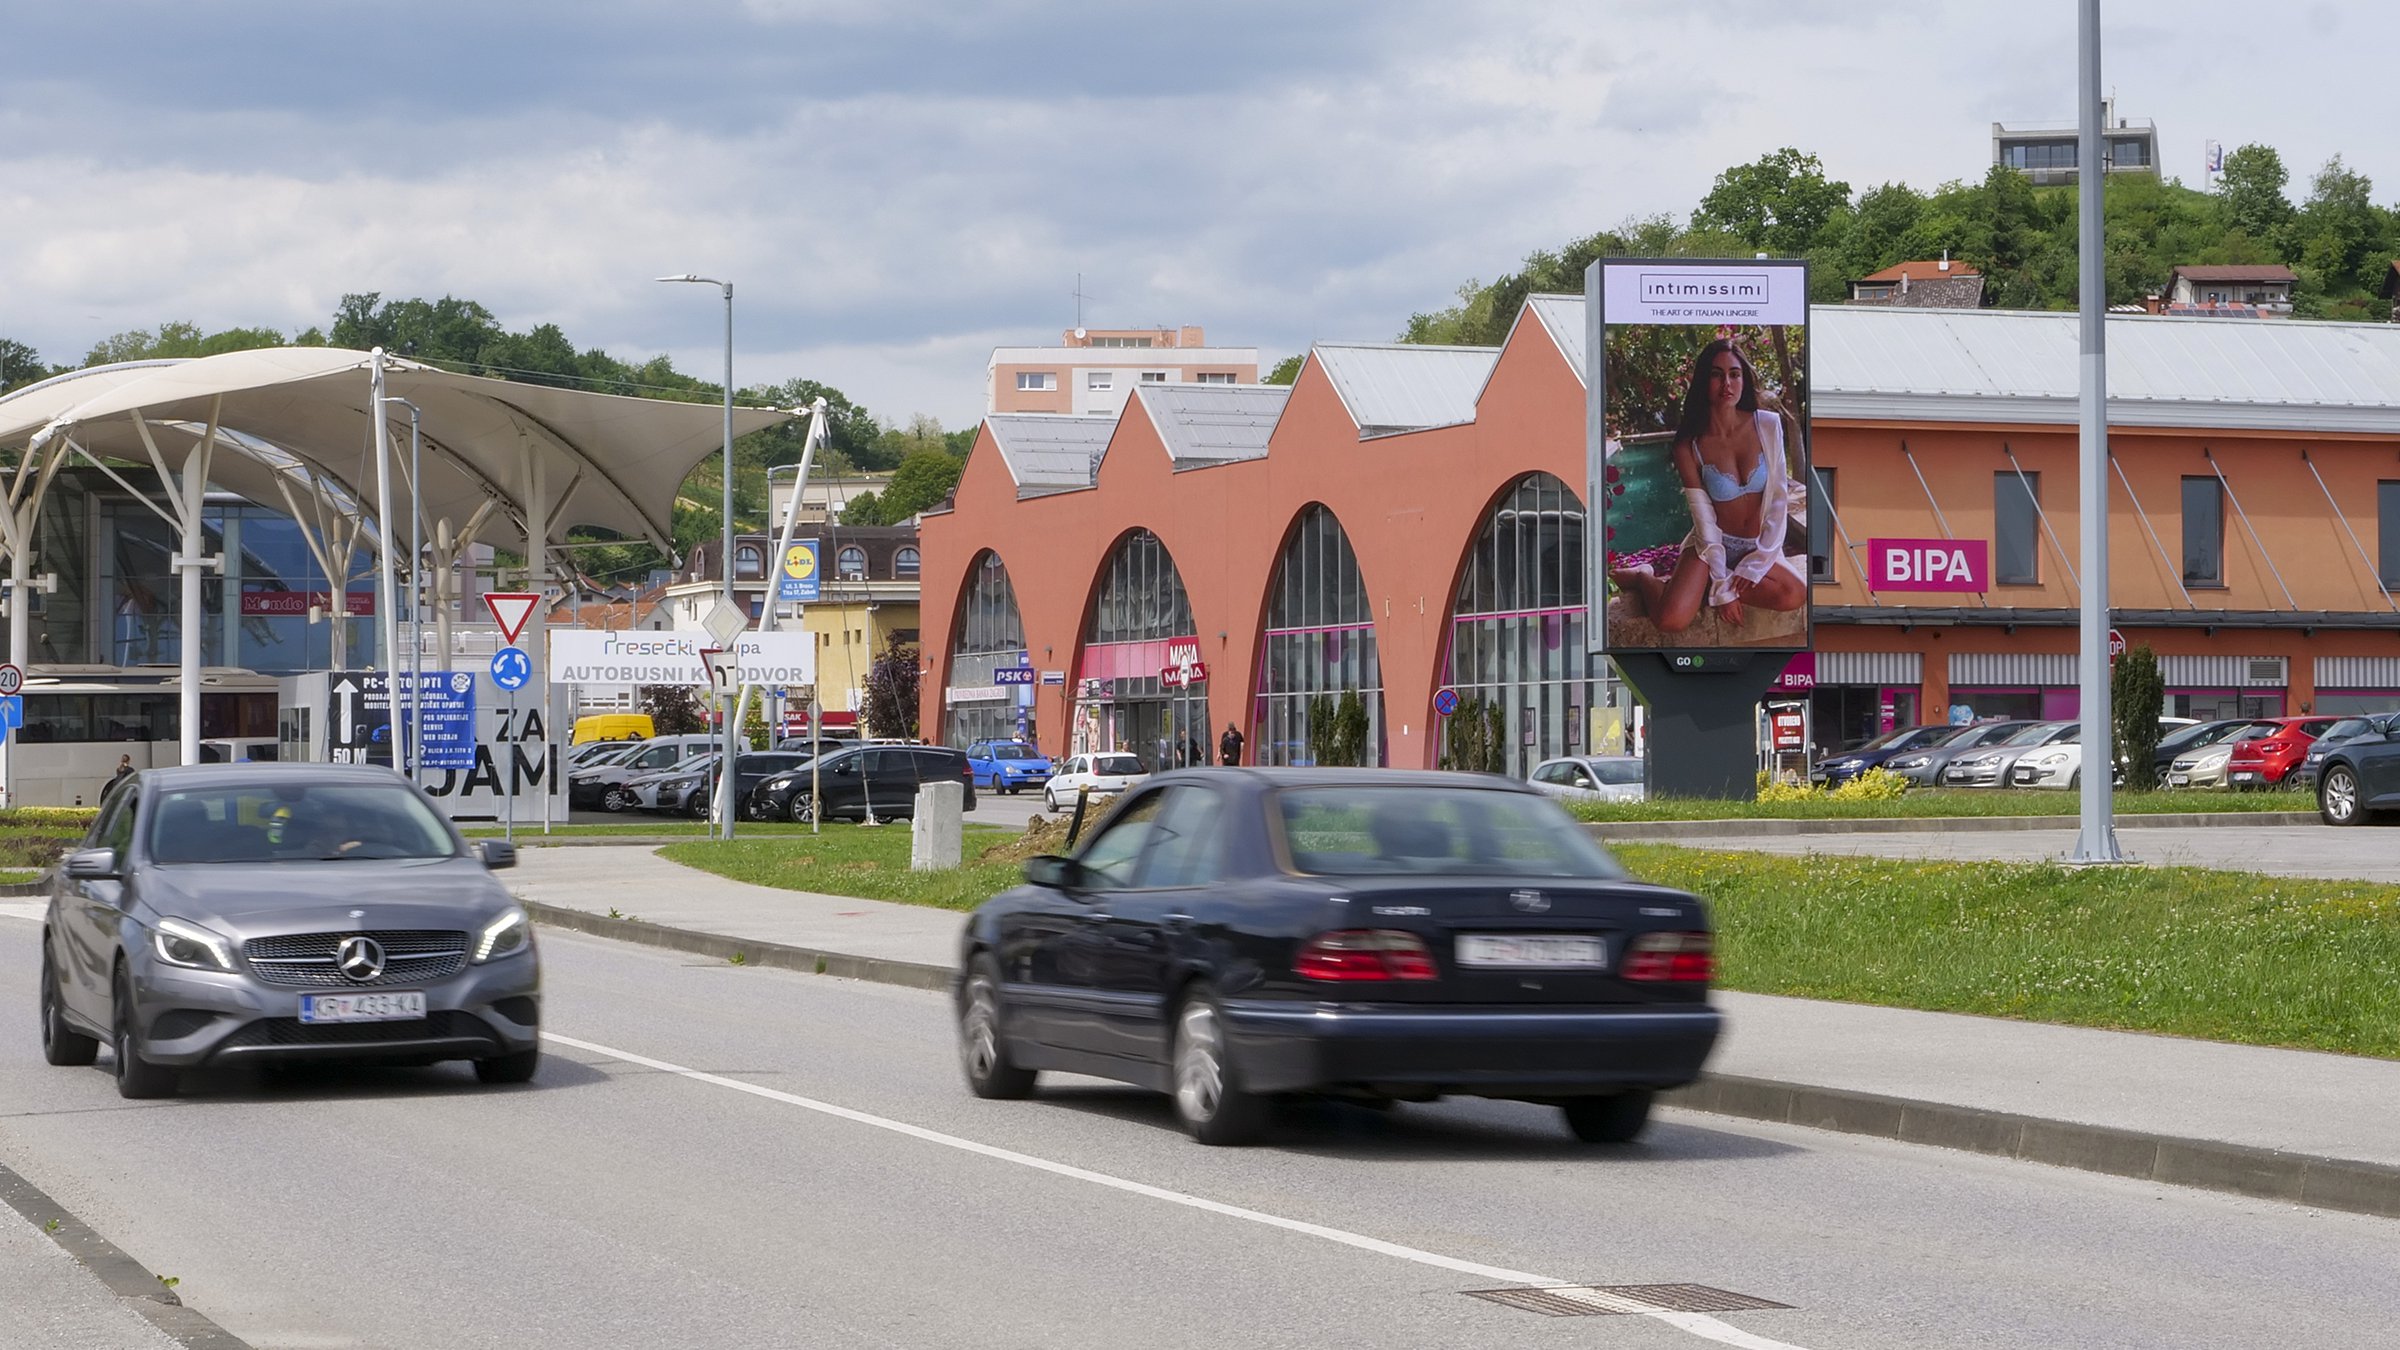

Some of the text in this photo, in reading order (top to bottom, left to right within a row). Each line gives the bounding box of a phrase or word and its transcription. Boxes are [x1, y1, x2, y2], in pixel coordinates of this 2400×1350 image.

[1648, 283, 1761, 296] intimissimi
[1695, 309, 1724, 317] ITALIAN
[1886, 548, 1974, 582] BIPA
[244, 597, 304, 611] Mondo
[710, 640, 761, 657] Gpa
[1676, 657, 1691, 666] GO
[1, 672, 17, 687] 20
[562, 666, 803, 682] AUTOBUSNI KODVOR
[996, 671, 1022, 682] PSK
[1784, 674, 1814, 686] BIPA
[495, 709, 545, 742] ZA
[333, 748, 367, 764] 50 M
